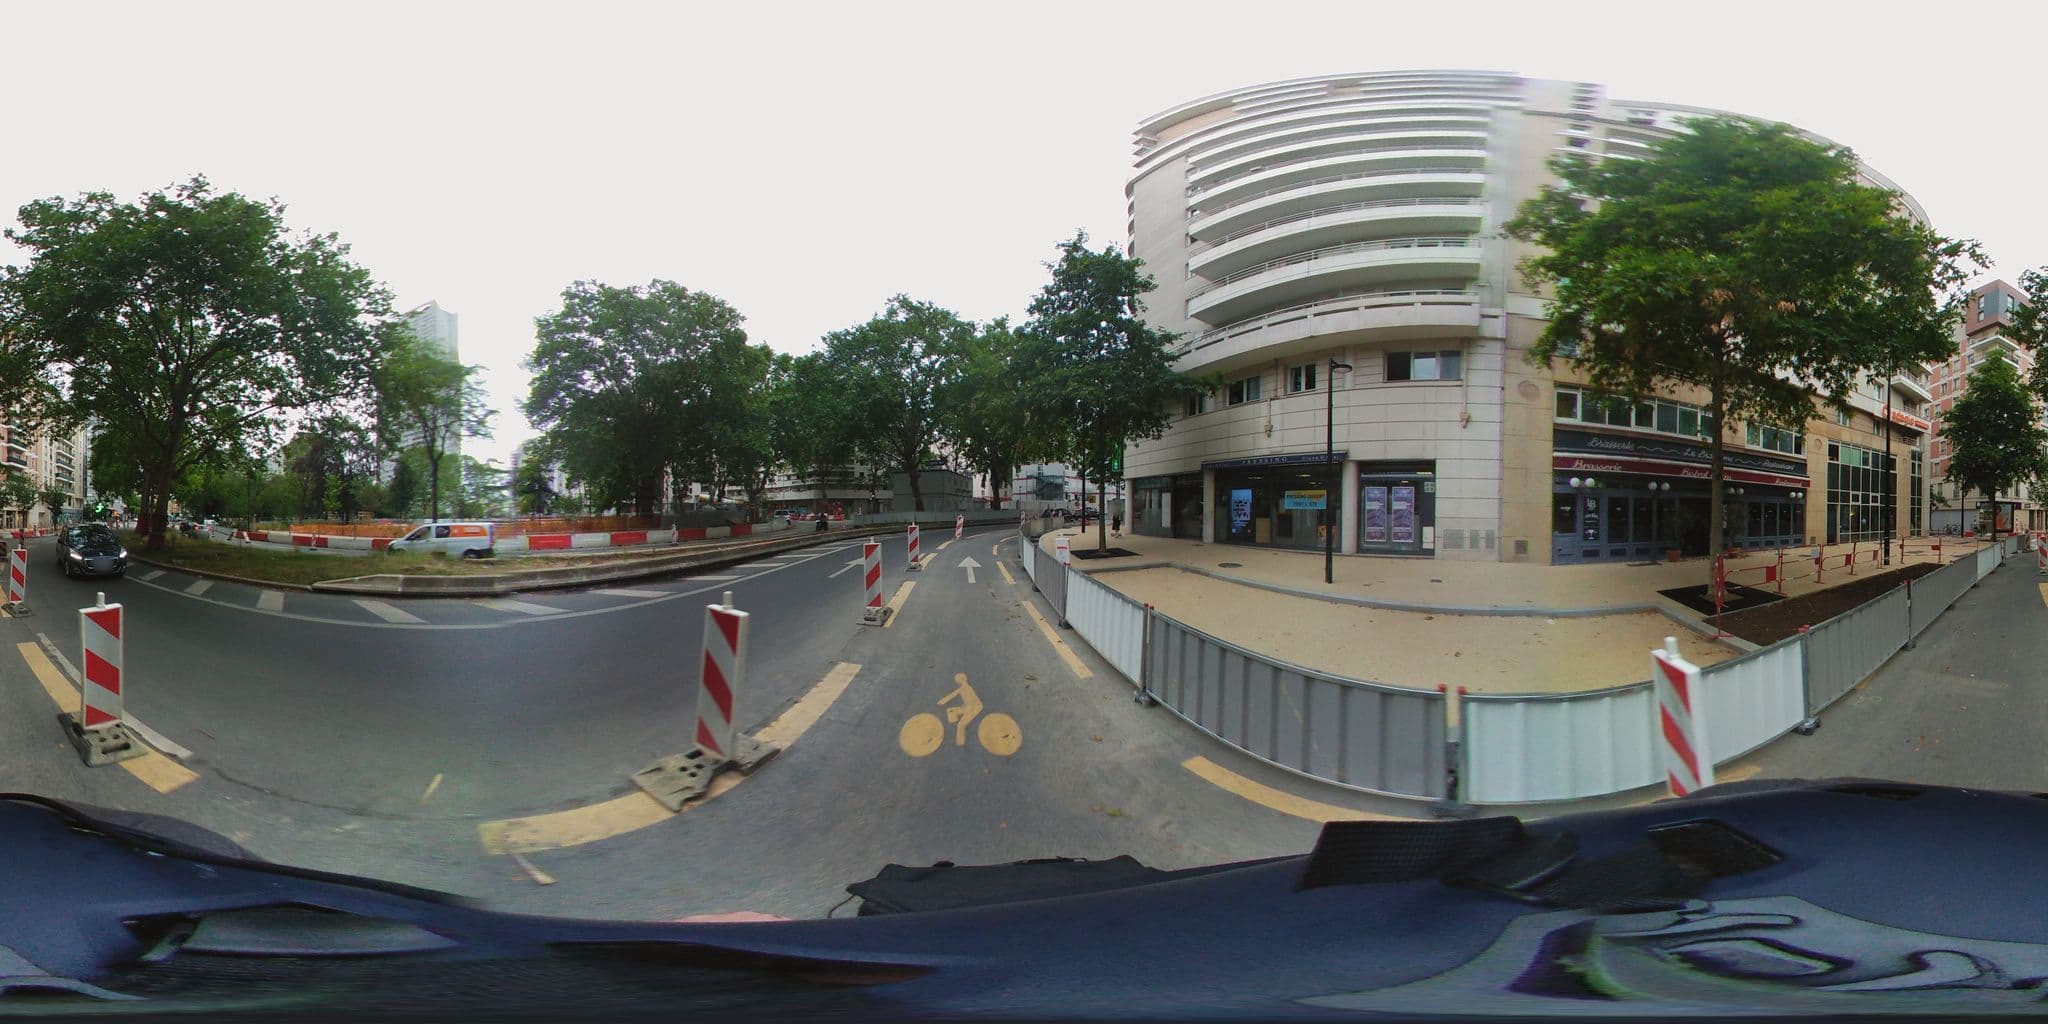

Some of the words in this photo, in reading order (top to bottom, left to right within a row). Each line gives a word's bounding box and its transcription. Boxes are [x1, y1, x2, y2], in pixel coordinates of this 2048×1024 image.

[1587, 437, 1635, 451] Brasserie
[1241, 456, 1288, 465] PRESSING
[1573, 459, 1623, 472] Brasserie
